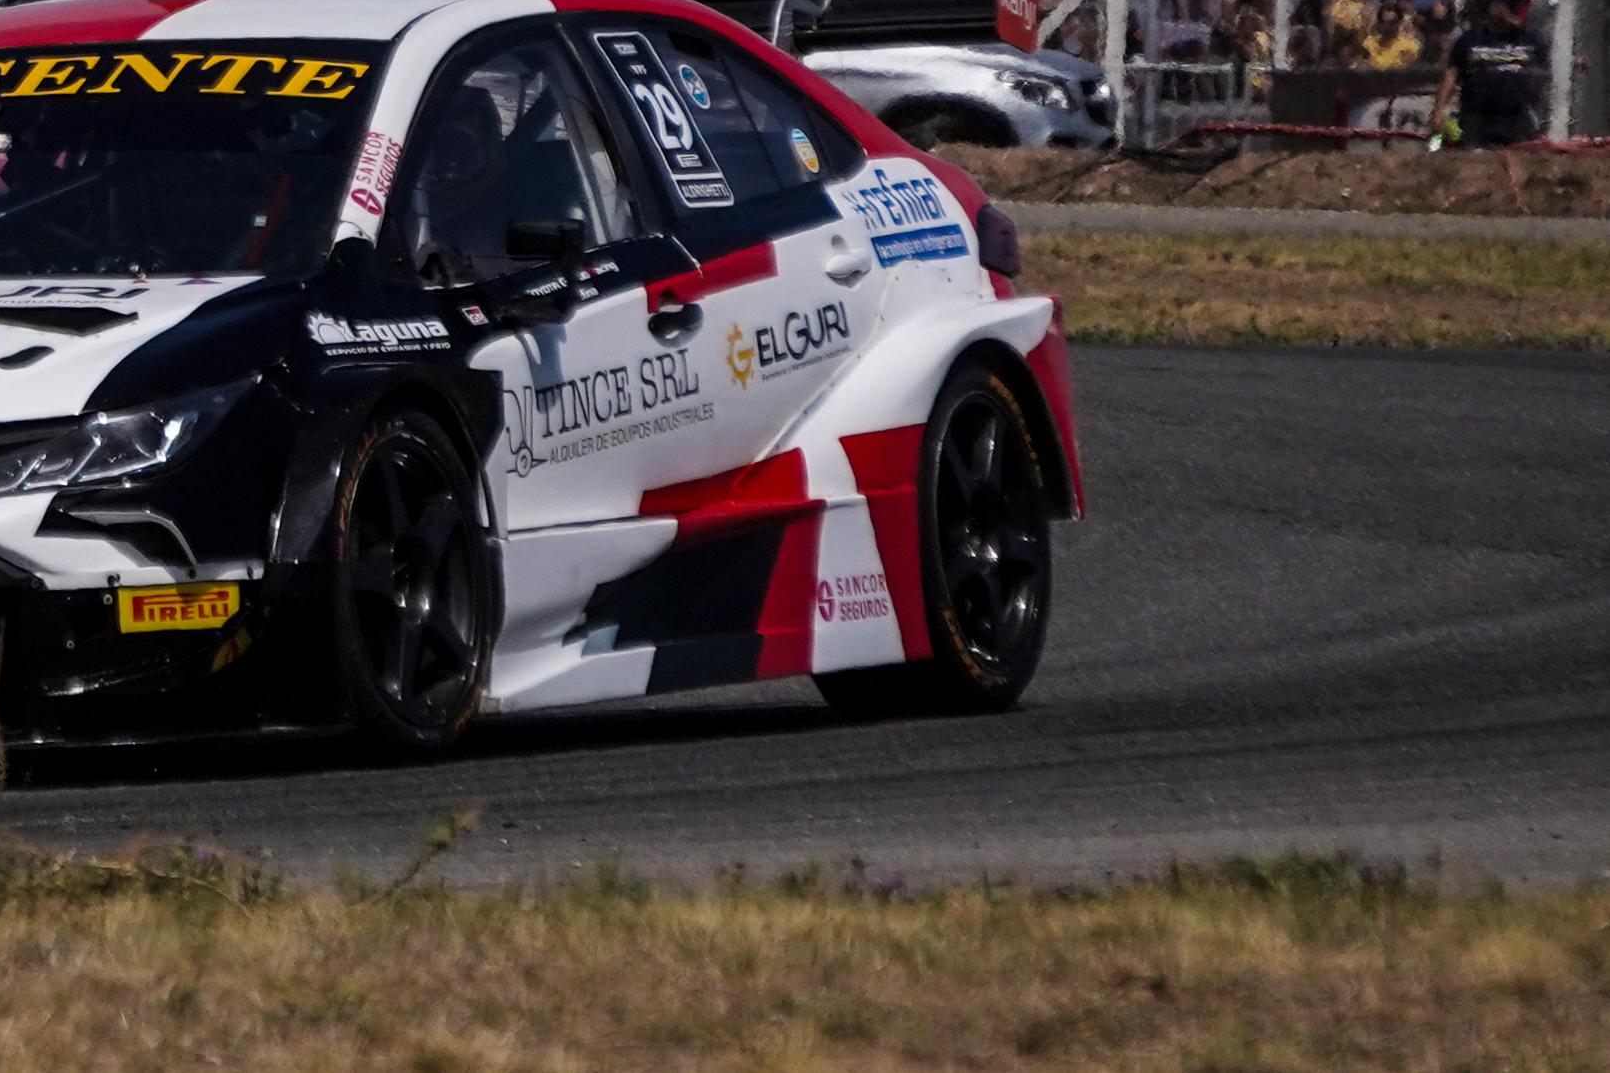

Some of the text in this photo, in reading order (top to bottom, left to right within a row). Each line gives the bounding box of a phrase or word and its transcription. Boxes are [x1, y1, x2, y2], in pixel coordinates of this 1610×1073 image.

[634, 83, 693, 151] 29
[355, 131, 386, 185] SANCOR
[374, 137, 402, 198] SEGUROS
[325, 345, 367, 357] SERVICIO
[534, 349, 700, 439] TINCE SRL
[549, 403, 715, 465] ALQUILER DE EQUIPOS INDUSTRIALES
[131, 590, 230, 624] PIRELLI
[835, 573, 887, 597] SANCOR
[839, 598, 889, 622] SEGUROS
